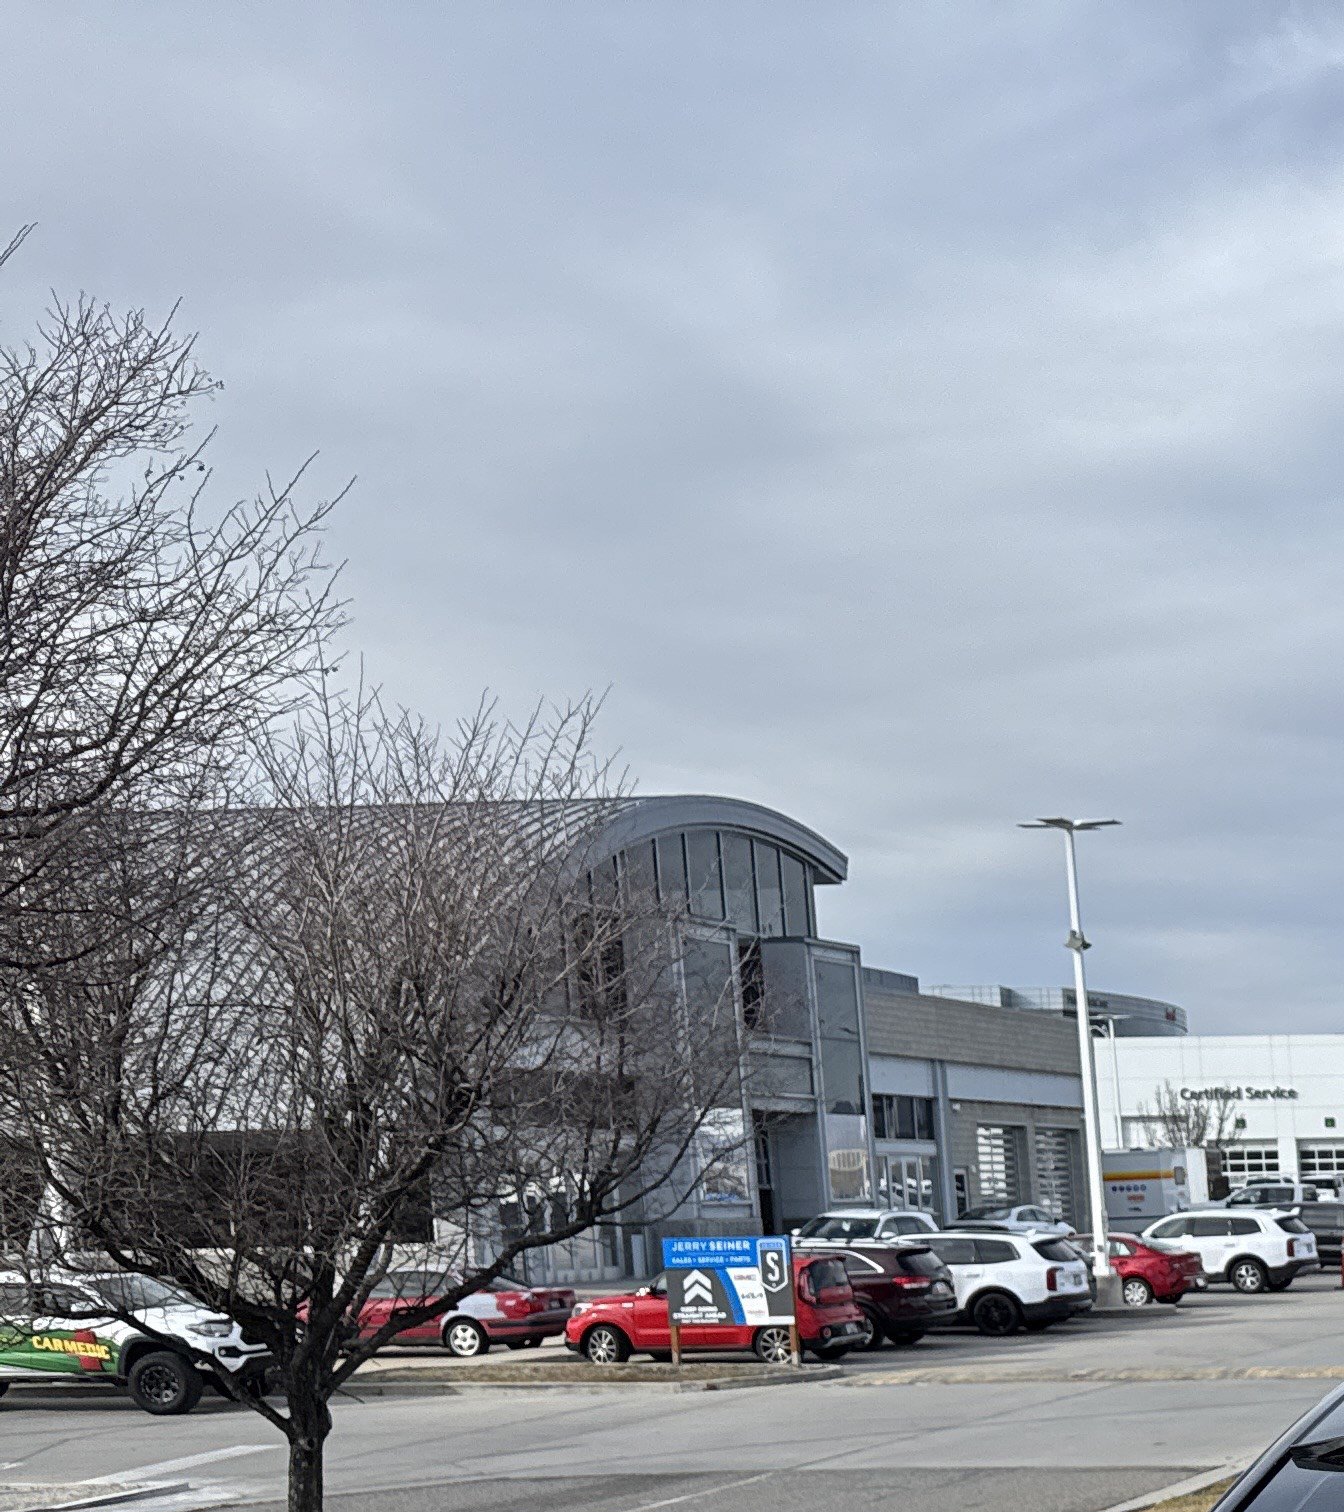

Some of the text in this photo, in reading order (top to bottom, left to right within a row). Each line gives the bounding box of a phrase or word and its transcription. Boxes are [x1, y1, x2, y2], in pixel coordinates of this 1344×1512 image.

[1180, 1086, 1299, 1100] Certified Service
[672, 1241, 707, 1252] JERRY
[31, 1335, 111, 1360] CARMEDIC
